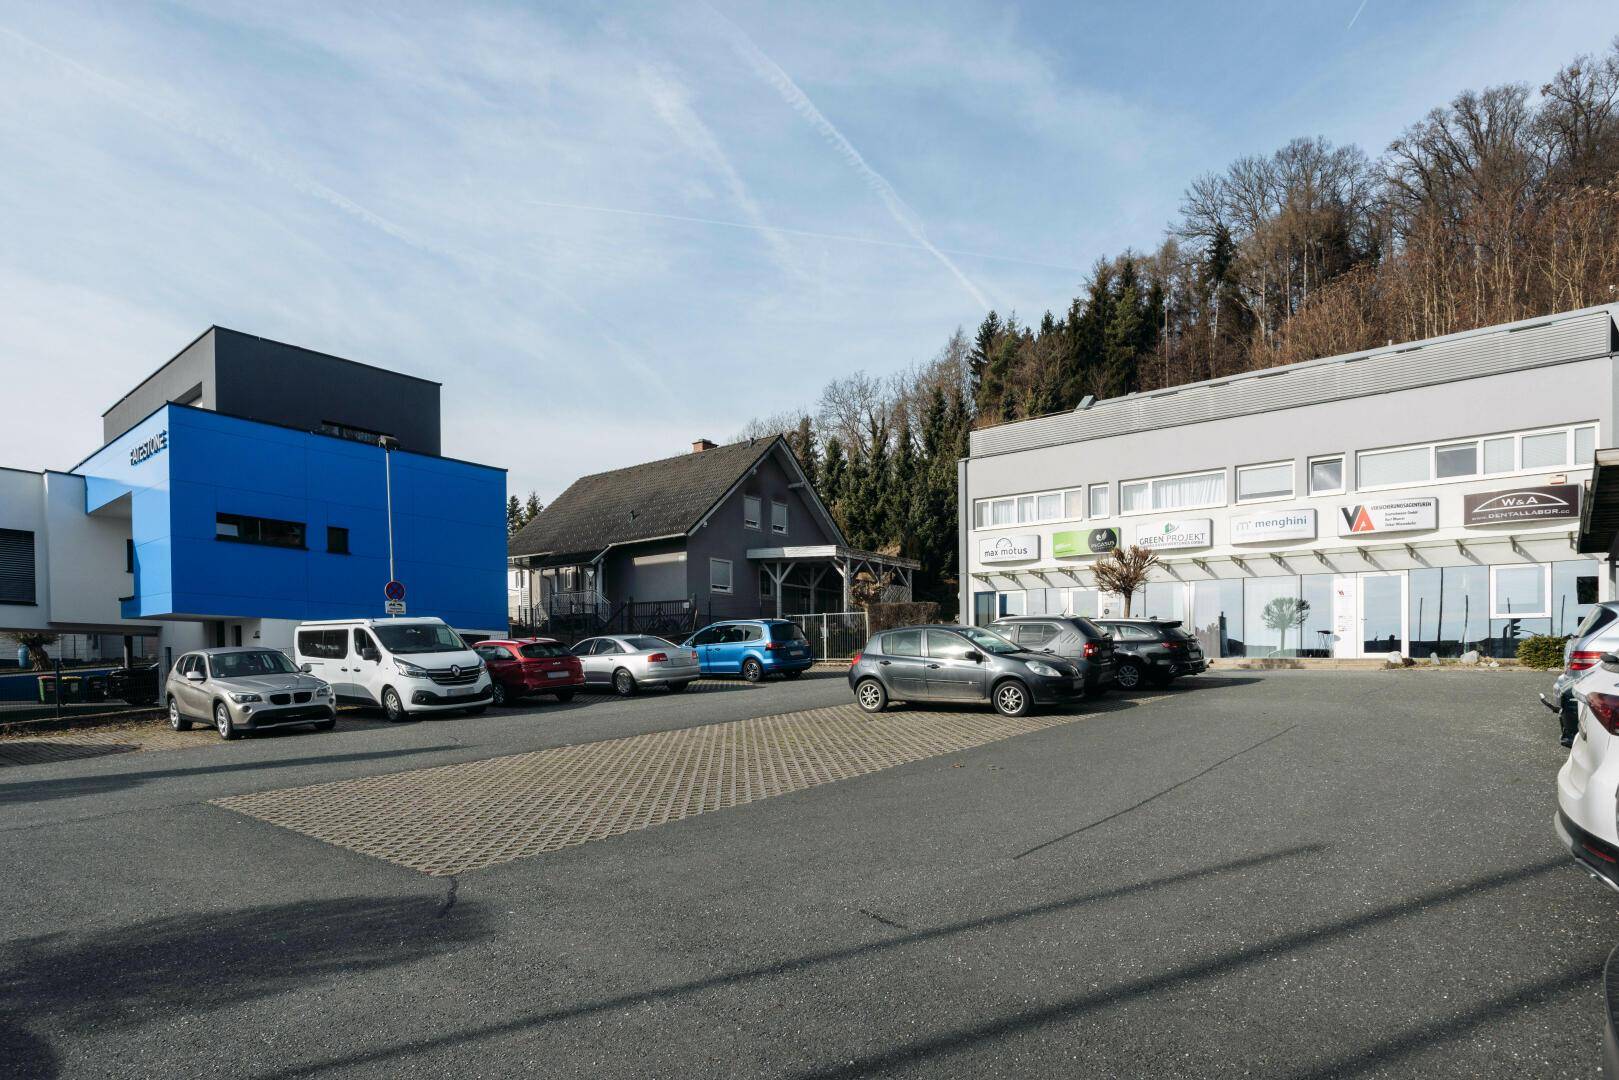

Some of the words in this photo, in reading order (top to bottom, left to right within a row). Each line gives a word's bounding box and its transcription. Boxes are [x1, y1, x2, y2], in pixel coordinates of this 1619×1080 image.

[1501, 496, 1539, 507] W&A
[1255, 515, 1307, 529] menghini
[1140, 536, 1164, 546] GREEN
[1166, 532, 1206, 542] PROJEKT
[1000, 547, 1028, 555] motus
